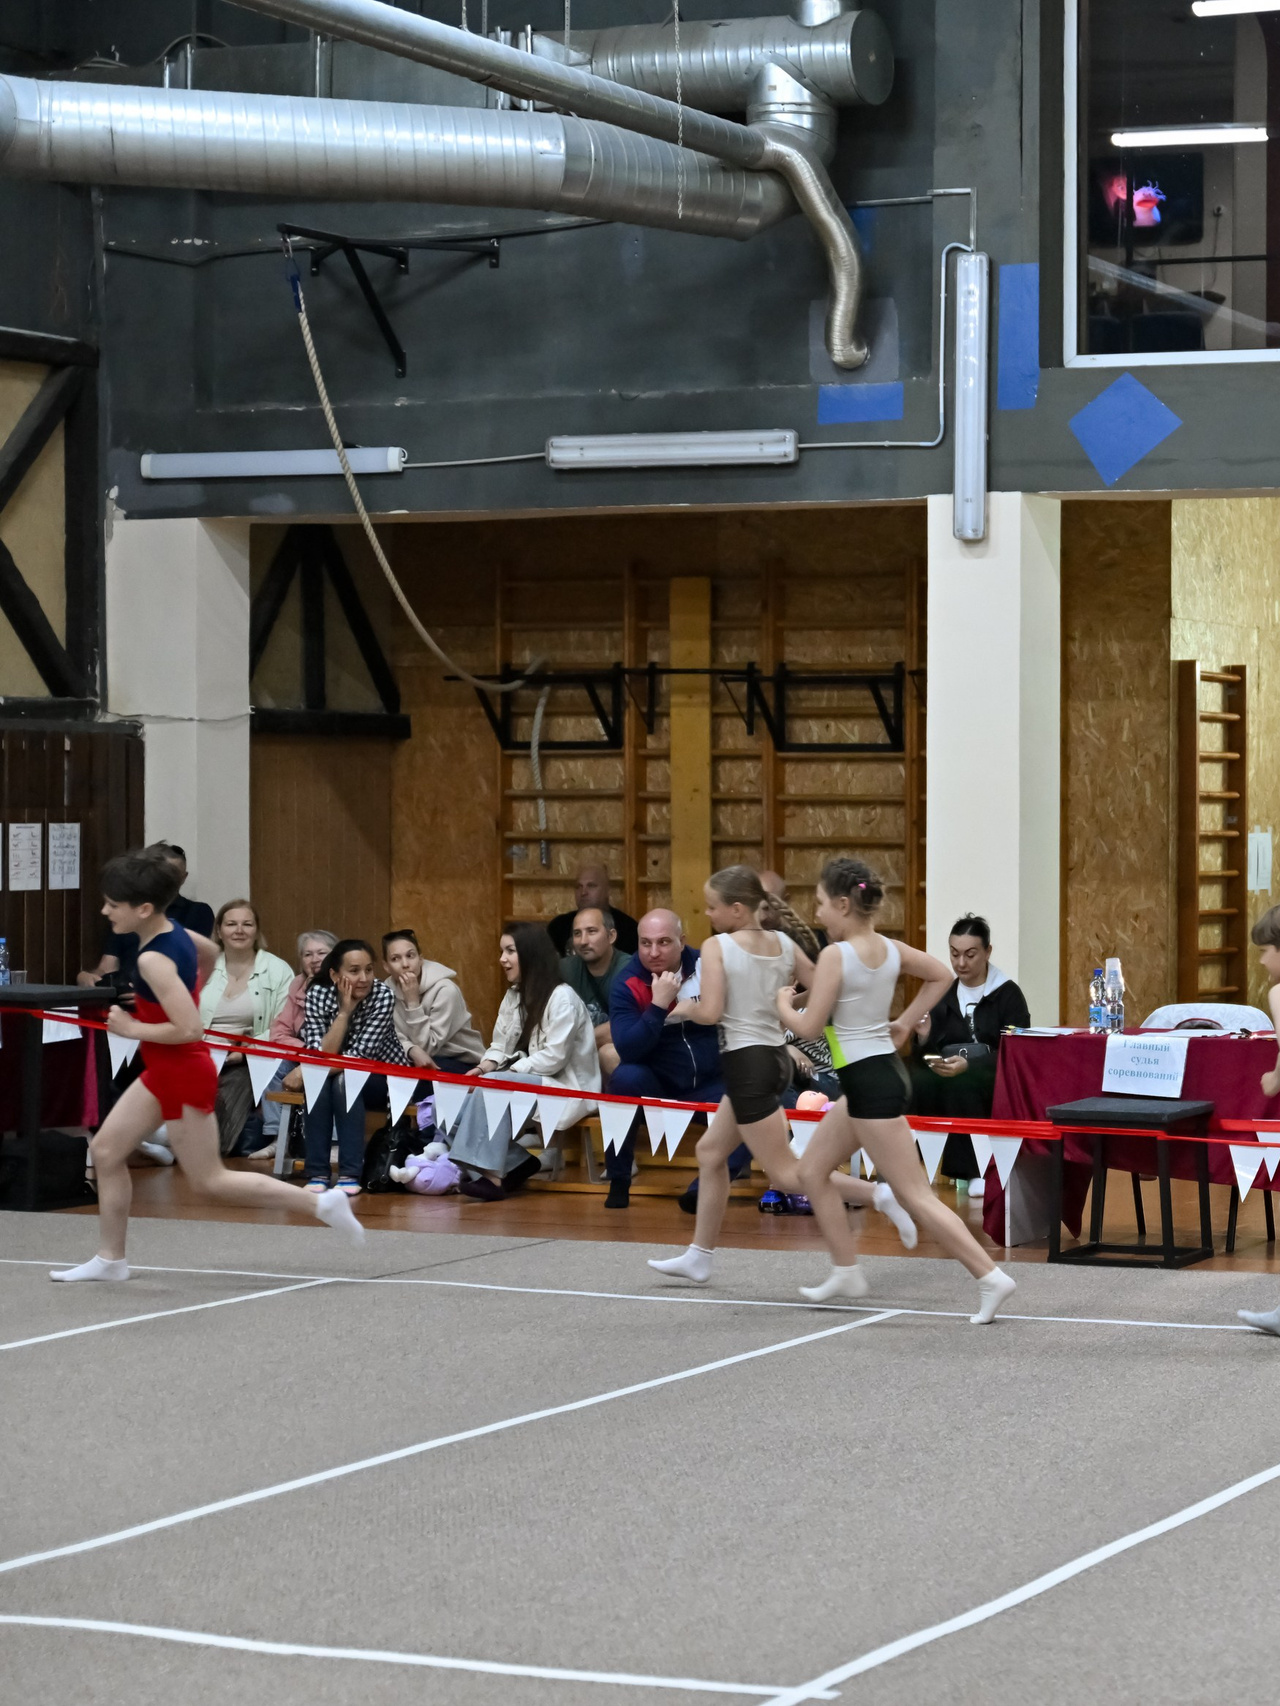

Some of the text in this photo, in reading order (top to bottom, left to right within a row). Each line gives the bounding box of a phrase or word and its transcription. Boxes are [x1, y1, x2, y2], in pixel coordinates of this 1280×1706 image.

[1123, 1039, 1170, 1052] Главный
[1130, 1055, 1160, 1066] судья
[1108, 1067, 1179, 1081] соревнований
